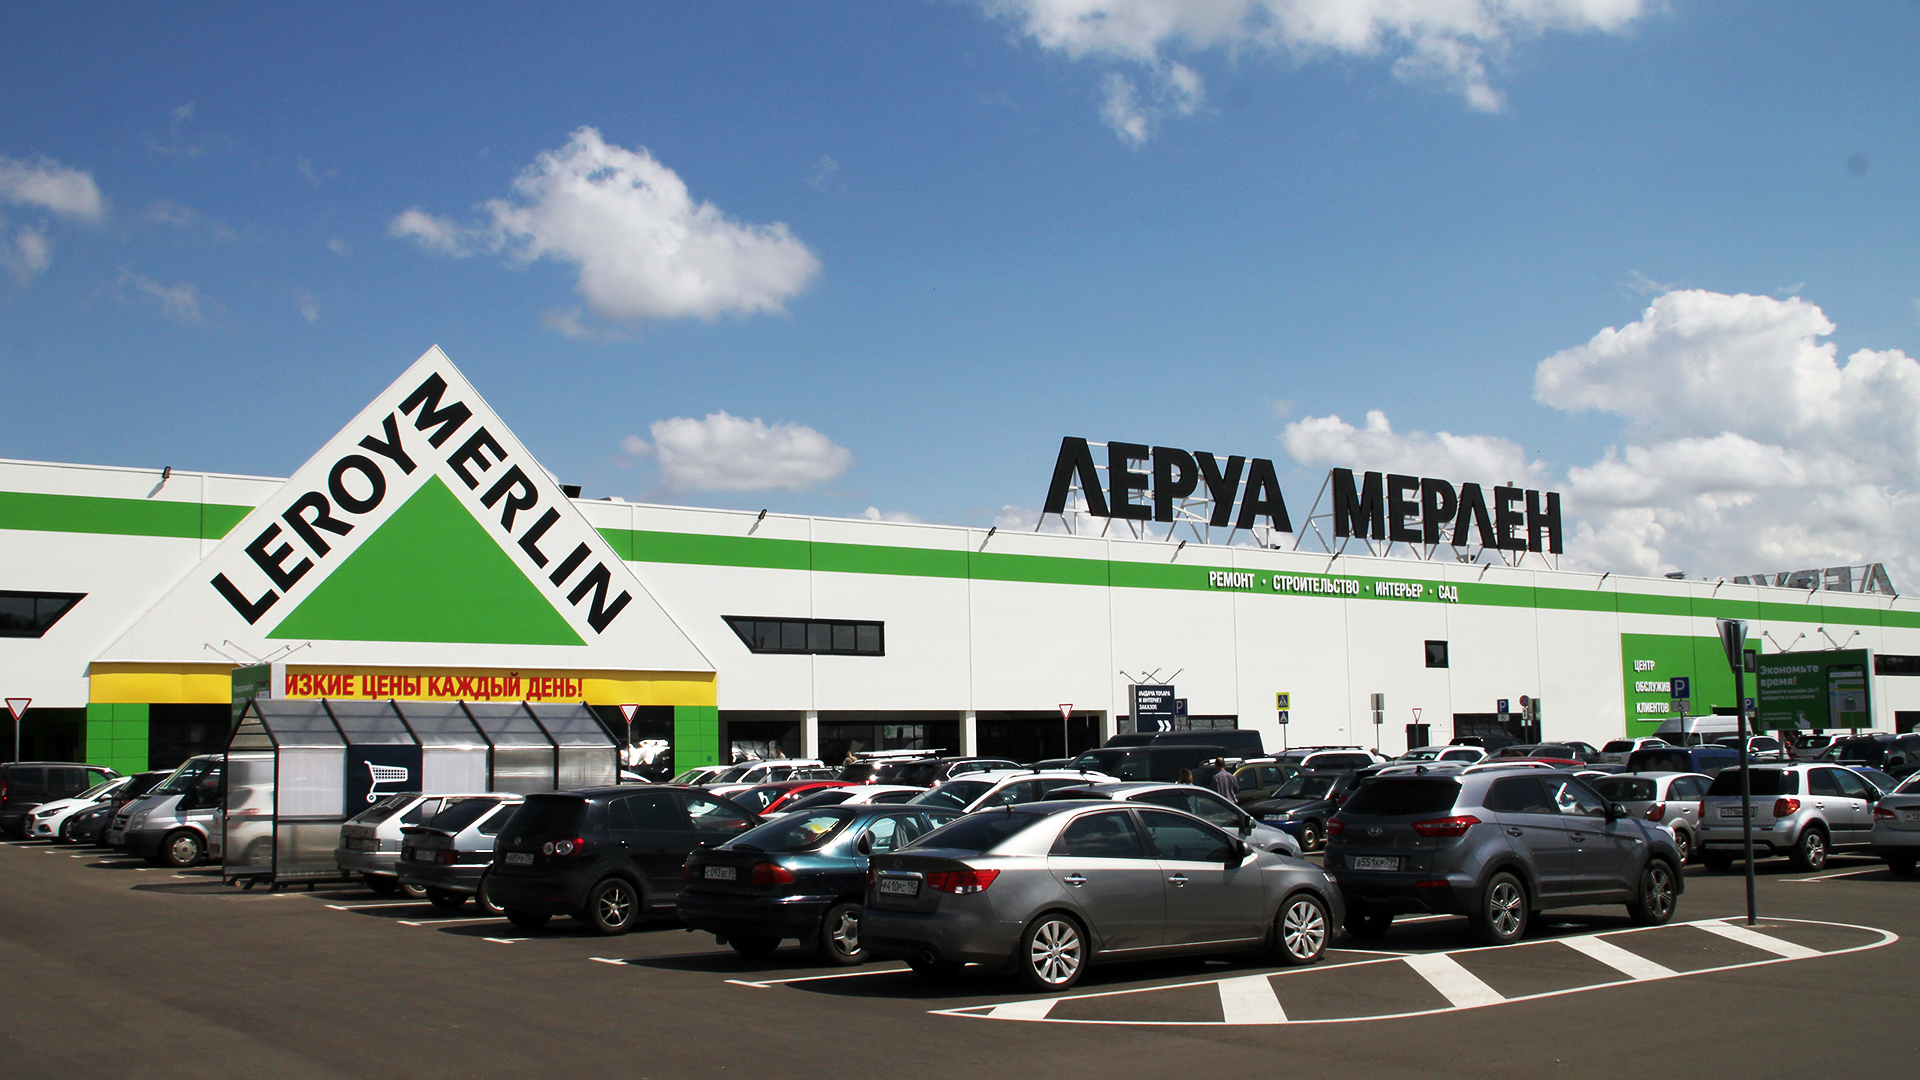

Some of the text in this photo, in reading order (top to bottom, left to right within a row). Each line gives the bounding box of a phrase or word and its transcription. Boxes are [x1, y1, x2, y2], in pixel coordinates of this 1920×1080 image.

[210, 371, 633, 635] LEROY MERLIN
[1043, 436, 1563, 554] ЛЕРУА МЕРЛЕН
[1209, 571, 1459, 602] РЕМОНТ СТРОИТЕЛЬСТВО ИНТЕРЬЕР САД
[1634, 660, 1655, 672] ЦЕНТР
[1760, 665, 1819, 675] Экономьте
[285, 672, 583, 701] ИЗКИЕ ЦЕНЫ КАЖДЫЙ ДЕНЬ!
[1760, 676, 1797, 688] время!
[1636, 703, 1669, 713] КЛИЕНТОВ
